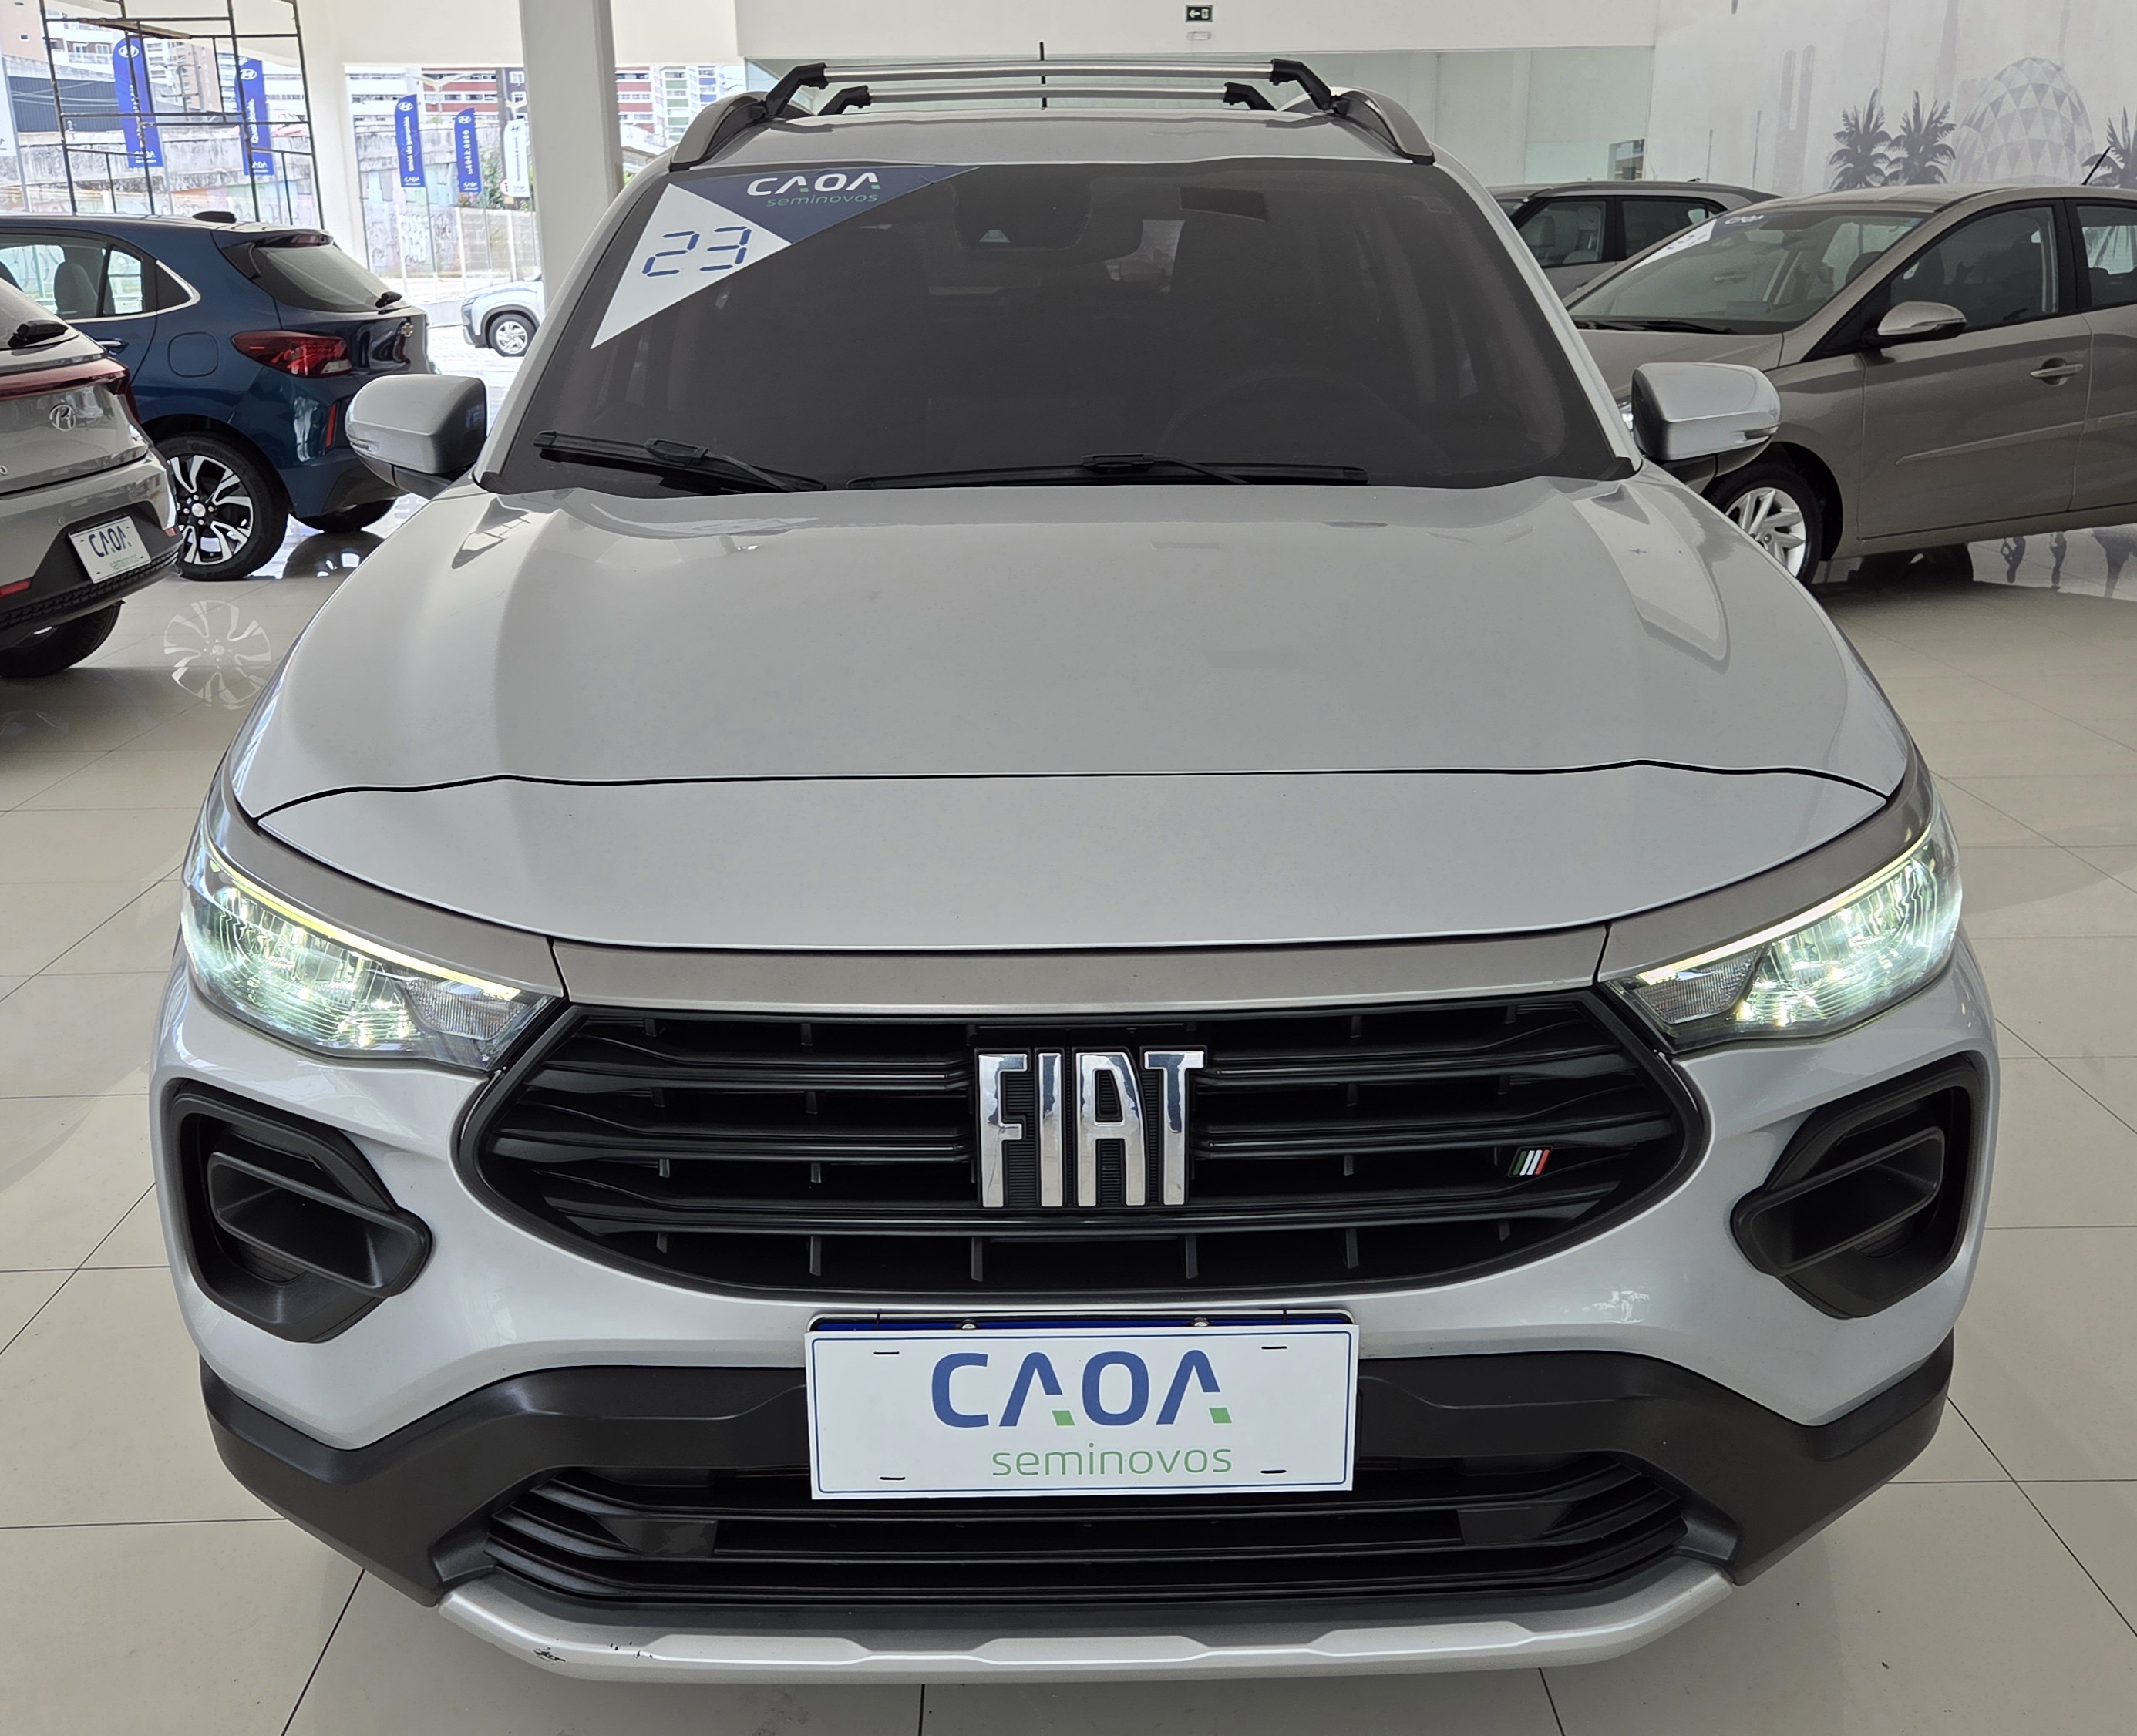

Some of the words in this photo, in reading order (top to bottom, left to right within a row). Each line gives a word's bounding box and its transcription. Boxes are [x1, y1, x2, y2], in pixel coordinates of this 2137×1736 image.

[746, 172, 882, 197] CAOA
[766, 193, 880, 207] seminovos
[641, 225, 752, 278] 23
[88, 525, 132, 558] CAOA
[978, 1050, 1206, 1208] FIAT
[931, 1349, 1233, 1428] CAOA
[991, 1442, 1233, 1477] seminovos
